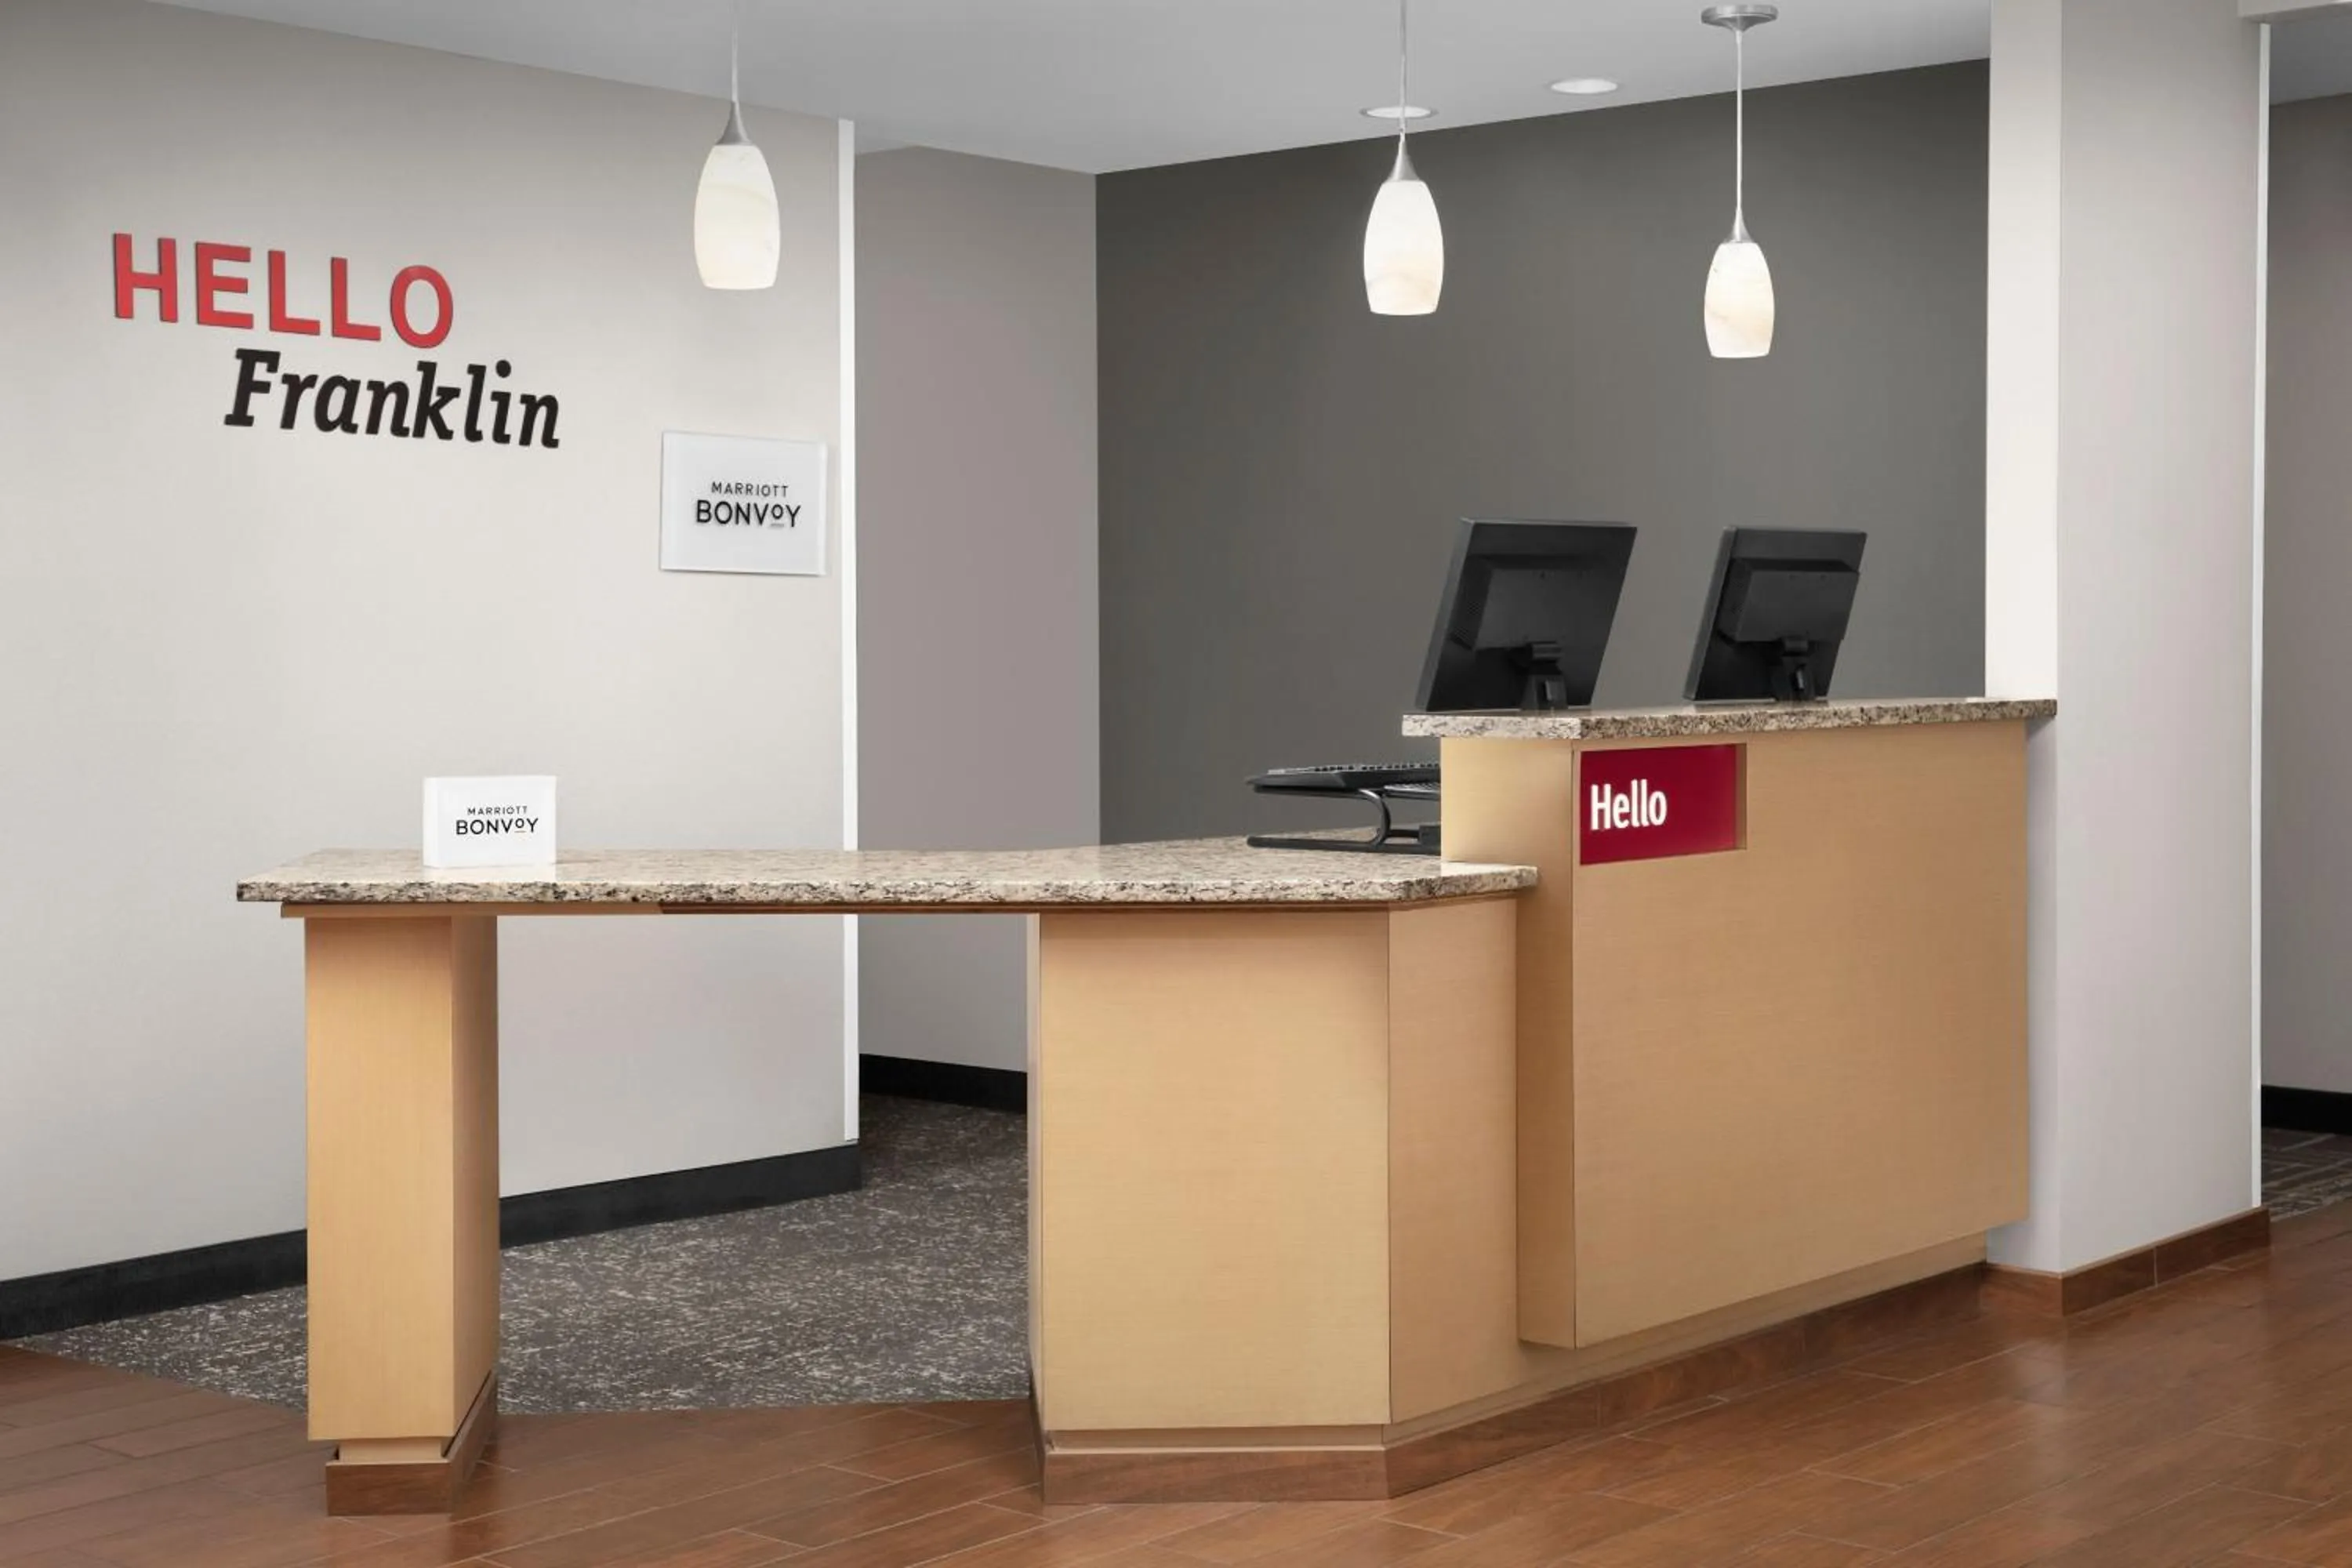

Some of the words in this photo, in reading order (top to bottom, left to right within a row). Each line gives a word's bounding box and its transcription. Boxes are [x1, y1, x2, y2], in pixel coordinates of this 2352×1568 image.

[113, 233, 453, 348] HELLO
[224, 347, 560, 448] Franklin
[711, 481, 788, 497] MARRIOTT
[467, 805, 528, 815] MARRIOTT
[1591, 779, 1668, 830] Hello
